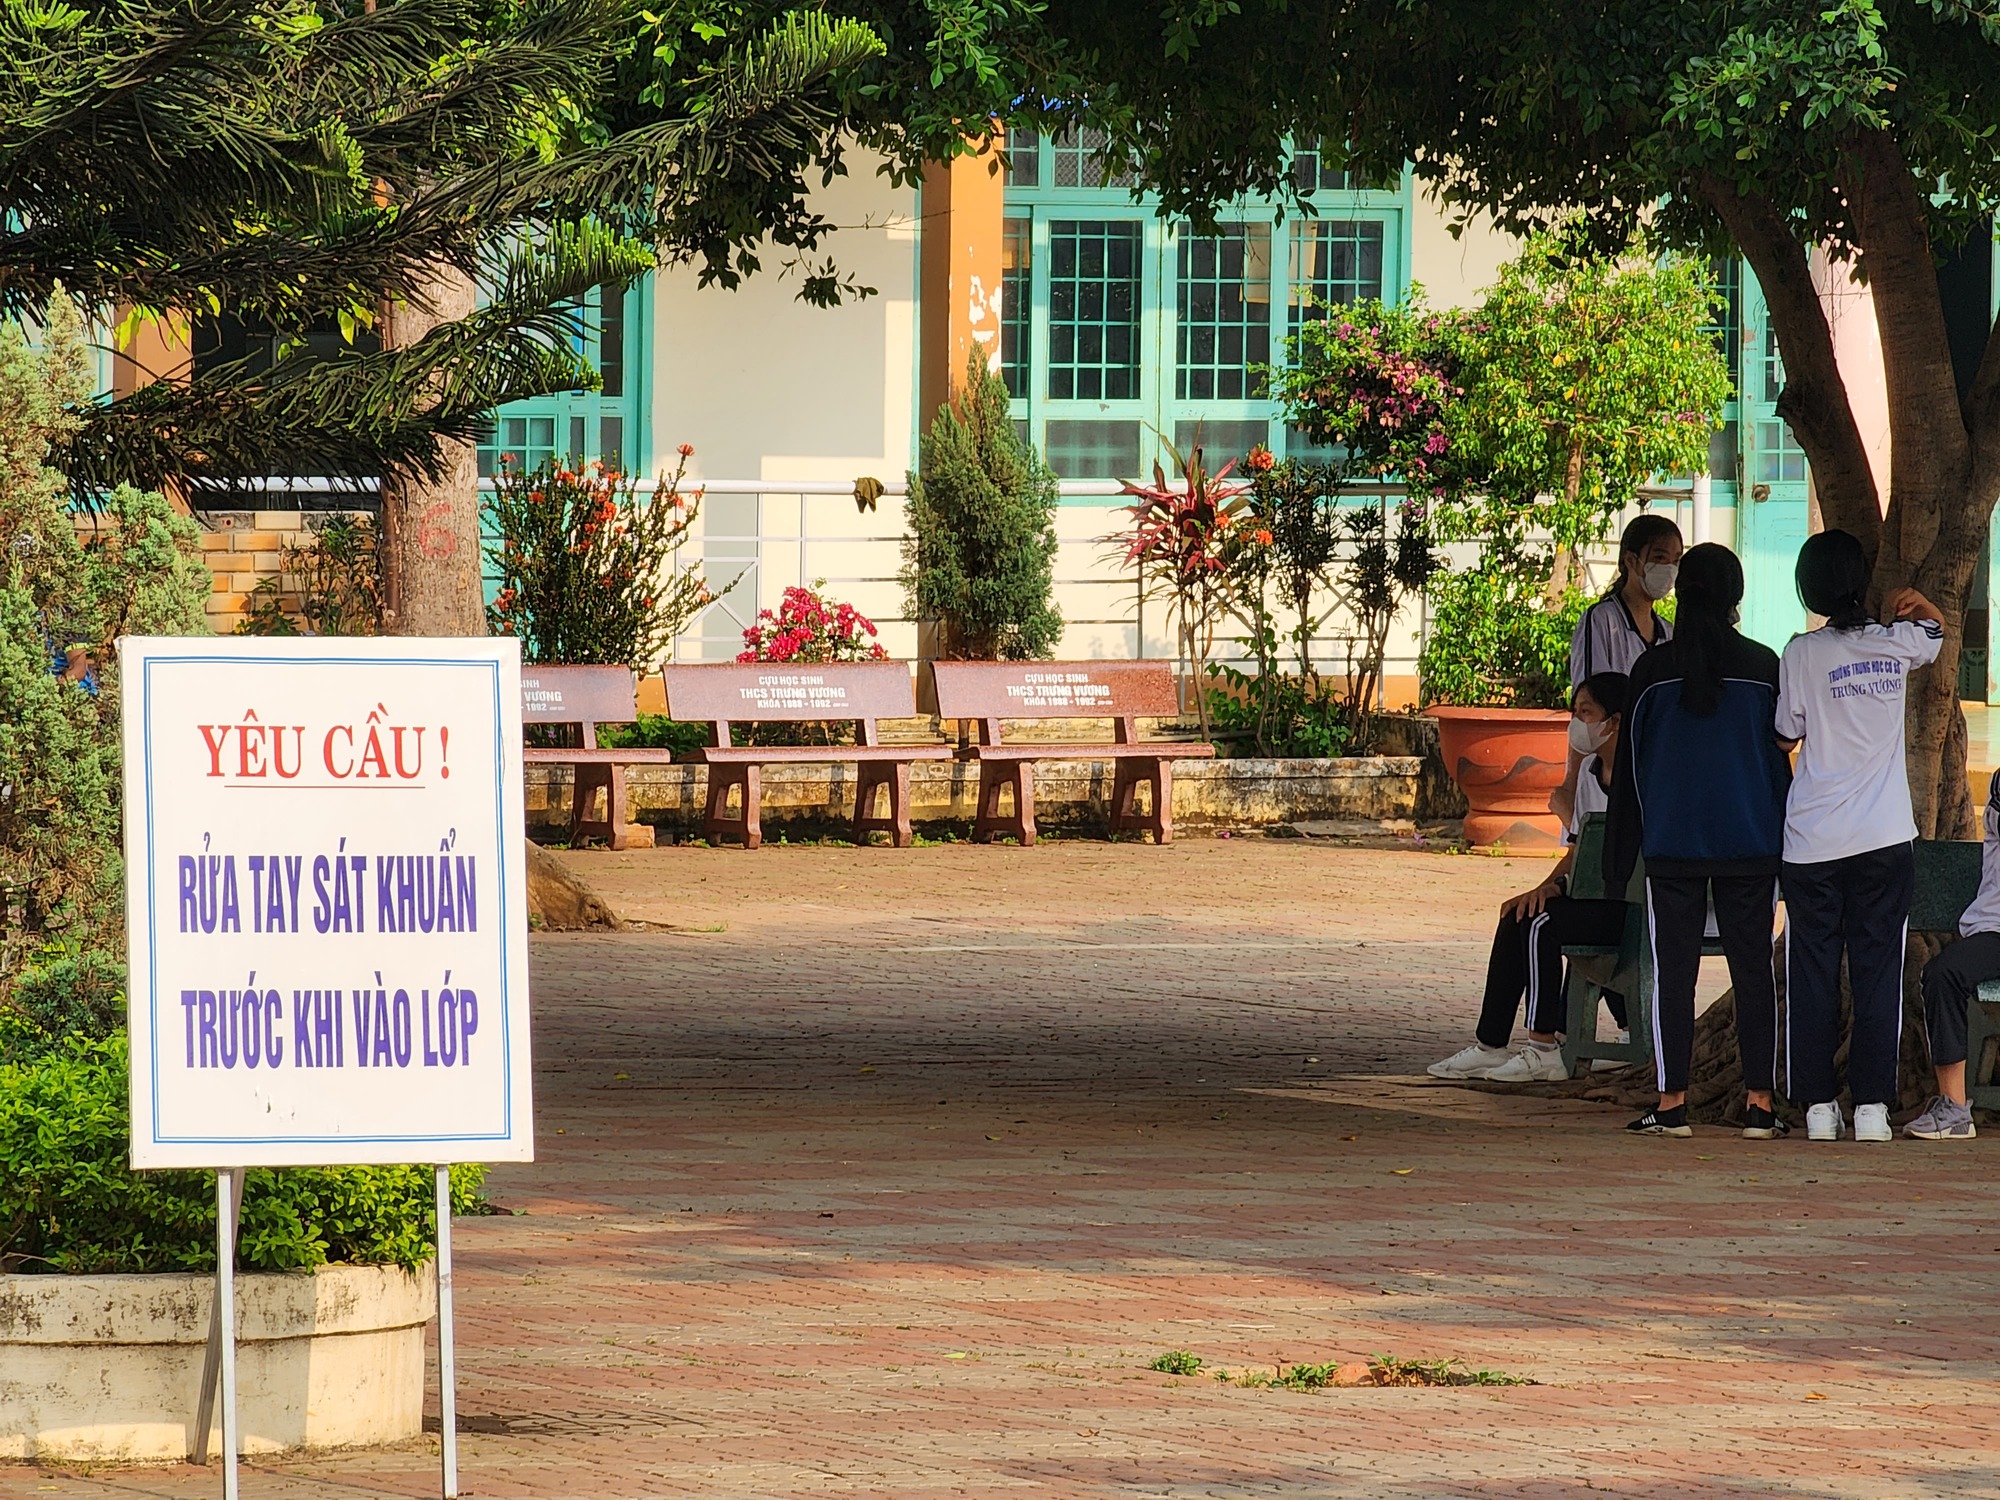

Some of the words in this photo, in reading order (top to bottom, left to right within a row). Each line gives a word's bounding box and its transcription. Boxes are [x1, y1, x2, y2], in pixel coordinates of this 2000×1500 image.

[418, 502, 457, 559] 6
[759, 676, 778, 686] CỰU
[780, 676, 799, 686] HỌC
[801, 676, 824, 685] SINH
[1025, 674, 1044, 684] CỰU
[1045, 674, 1064, 684] HỌC
[1066, 674, 1088, 683] SINH
[740, 688, 768, 699] THCS
[770, 687, 806, 699] TRƯNG
[808, 687, 845, 698] VƯƠNG
[1006, 686, 1034, 697] THCS
[1036, 685, 1072, 696] TRƯNG
[1073, 685, 1110, 696] VƯƠNG
[1830, 682, 1866, 699] TRƯNG
[1868, 678, 1902, 695] VƯƠNG
[524, 690, 563, 701] VƯƠNG
[1075, 697, 1096, 706] 1992
[526, 703, 547, 711] 1992
[810, 699, 831, 709] 1992
[198, 709, 305, 778] YÊU
[323, 703, 426, 779] CẦU
[440, 726, 450, 779] !
[179, 831, 241, 934] RỬA
[249, 855, 303, 934] TAY
[313, 837, 367, 934] SÁT
[377, 828, 478, 933] KHUẨN
[181, 971, 283, 1069] TRƯỚC
[294, 989, 344, 1068] KHI
[353, 971, 411, 1068] VÀO
[422, 970, 479, 1067] LỚP
